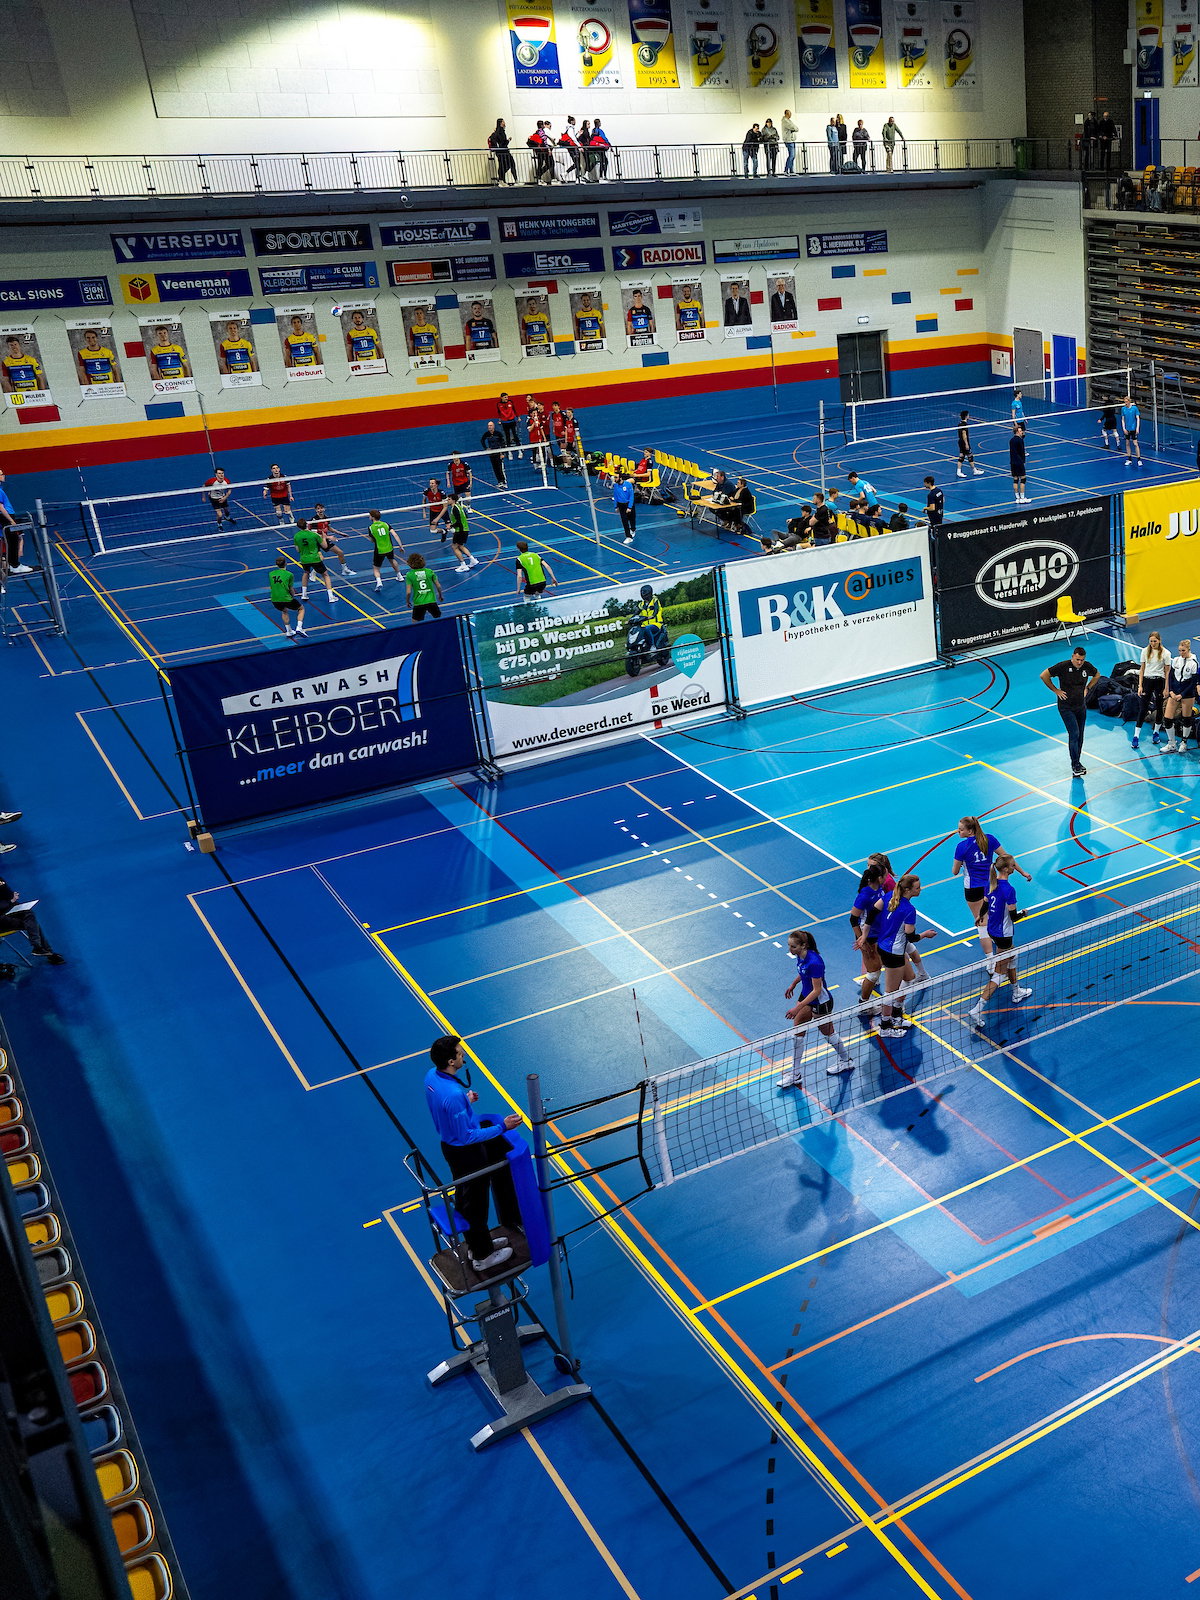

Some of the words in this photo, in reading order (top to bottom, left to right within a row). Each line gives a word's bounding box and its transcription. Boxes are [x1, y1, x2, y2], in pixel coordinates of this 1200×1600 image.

[529, 76, 549, 85] 1991
[591, 76, 610, 85] 1993
[649, 76, 667, 85] 1993
[703, 76, 720, 85] 1993
[519, 221, 540, 229] HENK
[541, 220, 555, 228] VAN
[557, 218, 596, 227] TONGEREN
[611, 216, 653, 230] MASTERMATE
[394, 228, 438, 242] HOUSE
[444, 226, 473, 238] TALL
[143, 233, 238, 249] VERSEPUT
[537, 254, 571, 267] Esra
[644, 248, 701, 262] RADIONL
[162, 278, 229, 290] Veeneman
[263, 277, 301, 287] KLEIBOER
[0, 291, 26, 301] C&L
[201, 287, 231, 297] BOUW
[686, 311, 693, 319] 22
[585, 320, 592, 328] 19
[479, 330, 485, 338] 17
[299, 346, 305, 354] 9
[360, 340, 368, 348] 10
[166, 357, 171, 365] 7
[235, 352, 241, 360] 8
[95, 362, 101, 370] 5
[19, 370, 26, 379] 3
[953, 527, 989, 539] Bruggestraat
[990, 525, 999, 534] 51,
[999, 520, 1028, 531] Harderwijk
[1038, 513, 1067, 524] Marktplein
[1067, 511, 1076, 519] 17,
[1076, 506, 1103, 516] Apeldoorn
[377, 527, 386, 536] 10
[1130, 521, 1162, 539] Hallo
[302, 538, 309, 547] 5
[527, 557, 534, 566] 7
[994, 551, 1068, 592] MAJO
[419, 579, 427, 590] 6
[994, 589, 1017, 600] verse
[1020, 584, 1039, 595] friet
[758, 582, 846, 635] B&K
[852, 568, 914, 592] advies
[494, 623, 524, 638] Alle
[527, 607, 610, 633] rijbewijzen
[957, 632, 992, 645] Bruggestraat
[992, 630, 1001, 638] 51,
[1002, 623, 1031, 634] Harderwijk
[1078, 606, 1103, 617] Apeldoorn
[496, 641, 516, 657] bij
[518, 637, 539, 651] De
[541, 625, 591, 646] Weerd
[594, 619, 624, 634] met
[498, 648, 551, 671] €75,00
[554, 638, 615, 661] Dynamo
[500, 664, 561, 686] korting!
[248, 669, 390, 708] CARWASH
[651, 703, 669, 716] De
[671, 692, 711, 712] Weerd
[226, 695, 402, 759] KLEIBOER
[511, 712, 634, 749] www.deweerd.net
[309, 752, 344, 770] dan
[348, 728, 428, 761] carwash!
[973, 851, 987, 863] 11
[990, 895, 996, 909] 2
